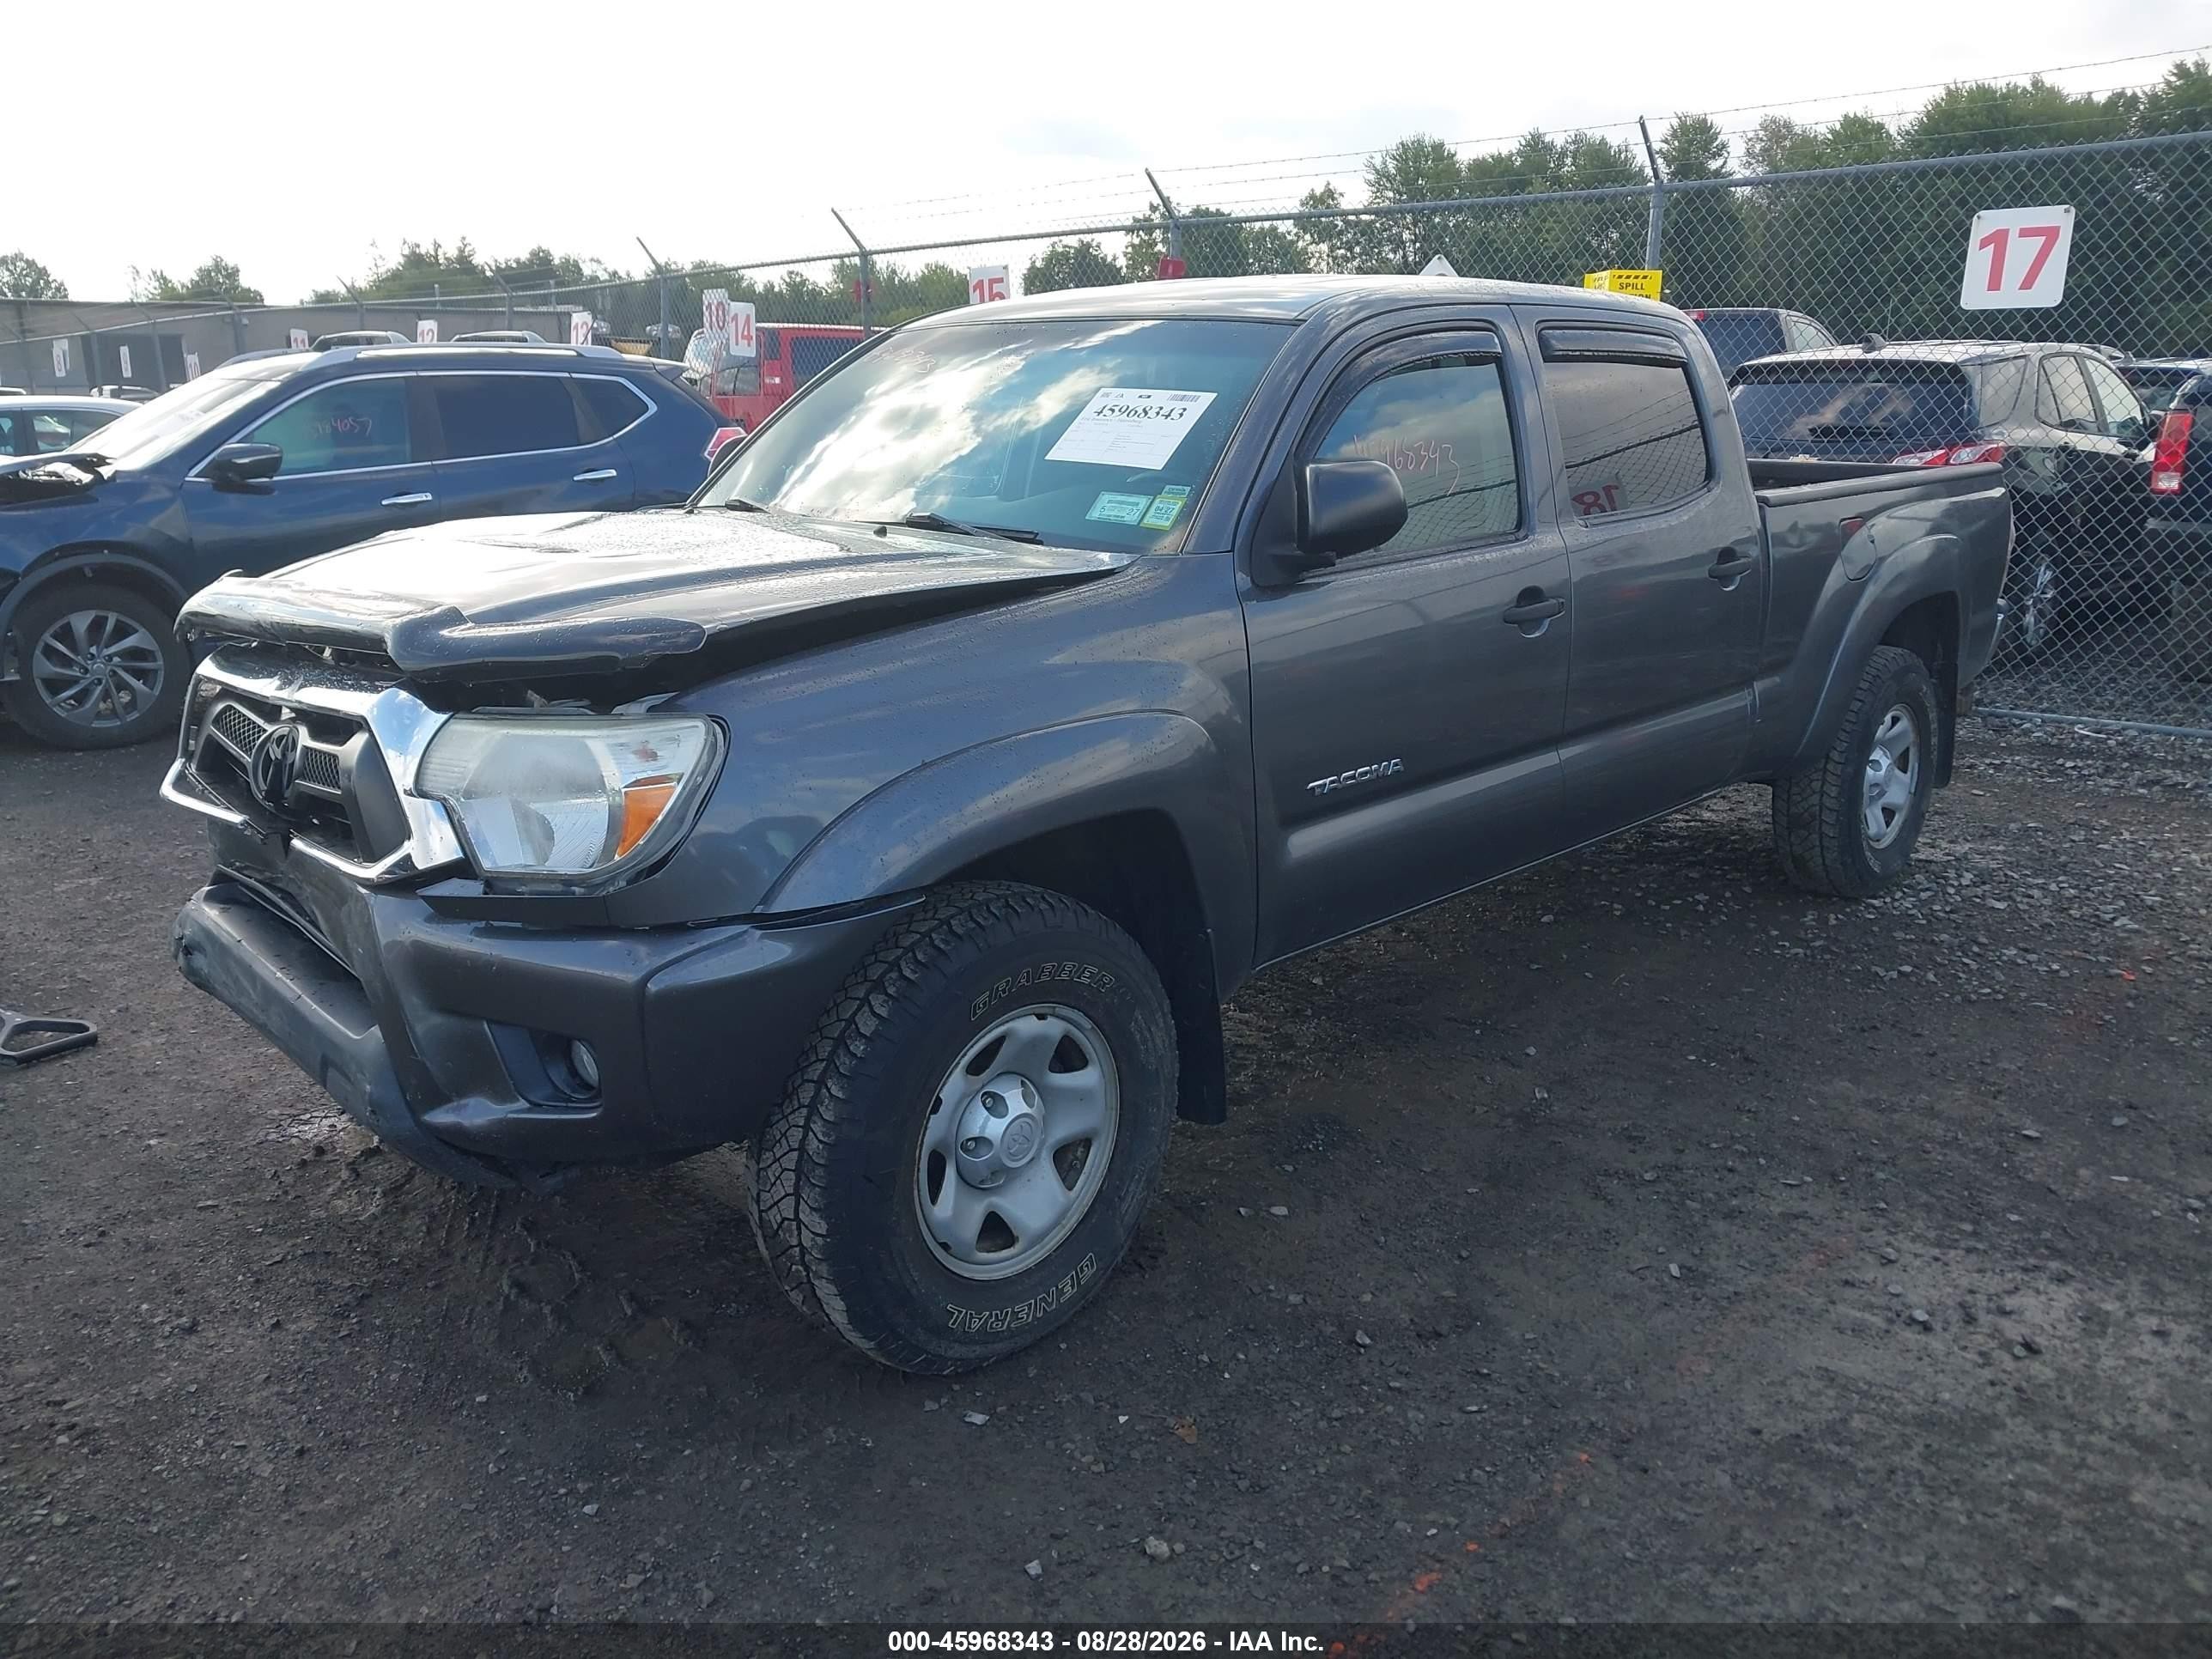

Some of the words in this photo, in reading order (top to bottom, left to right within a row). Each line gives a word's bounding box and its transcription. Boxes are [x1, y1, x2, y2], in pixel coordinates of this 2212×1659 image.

[1978, 225, 2061, 292] 17
[972, 276, 1006, 303] 15
[1619, 282, 1645, 290] SPILL
[705, 301, 726, 331] 10
[731, 313, 753, 347] 14
[1093, 403, 1188, 421] 45968343
[1127, 507, 1140, 516] 27
[1306, 758, 1404, 796] TACOMA
[970, 962, 1115, 1021] GRABBER
[946, 1252, 1097, 1332] GENERAL
